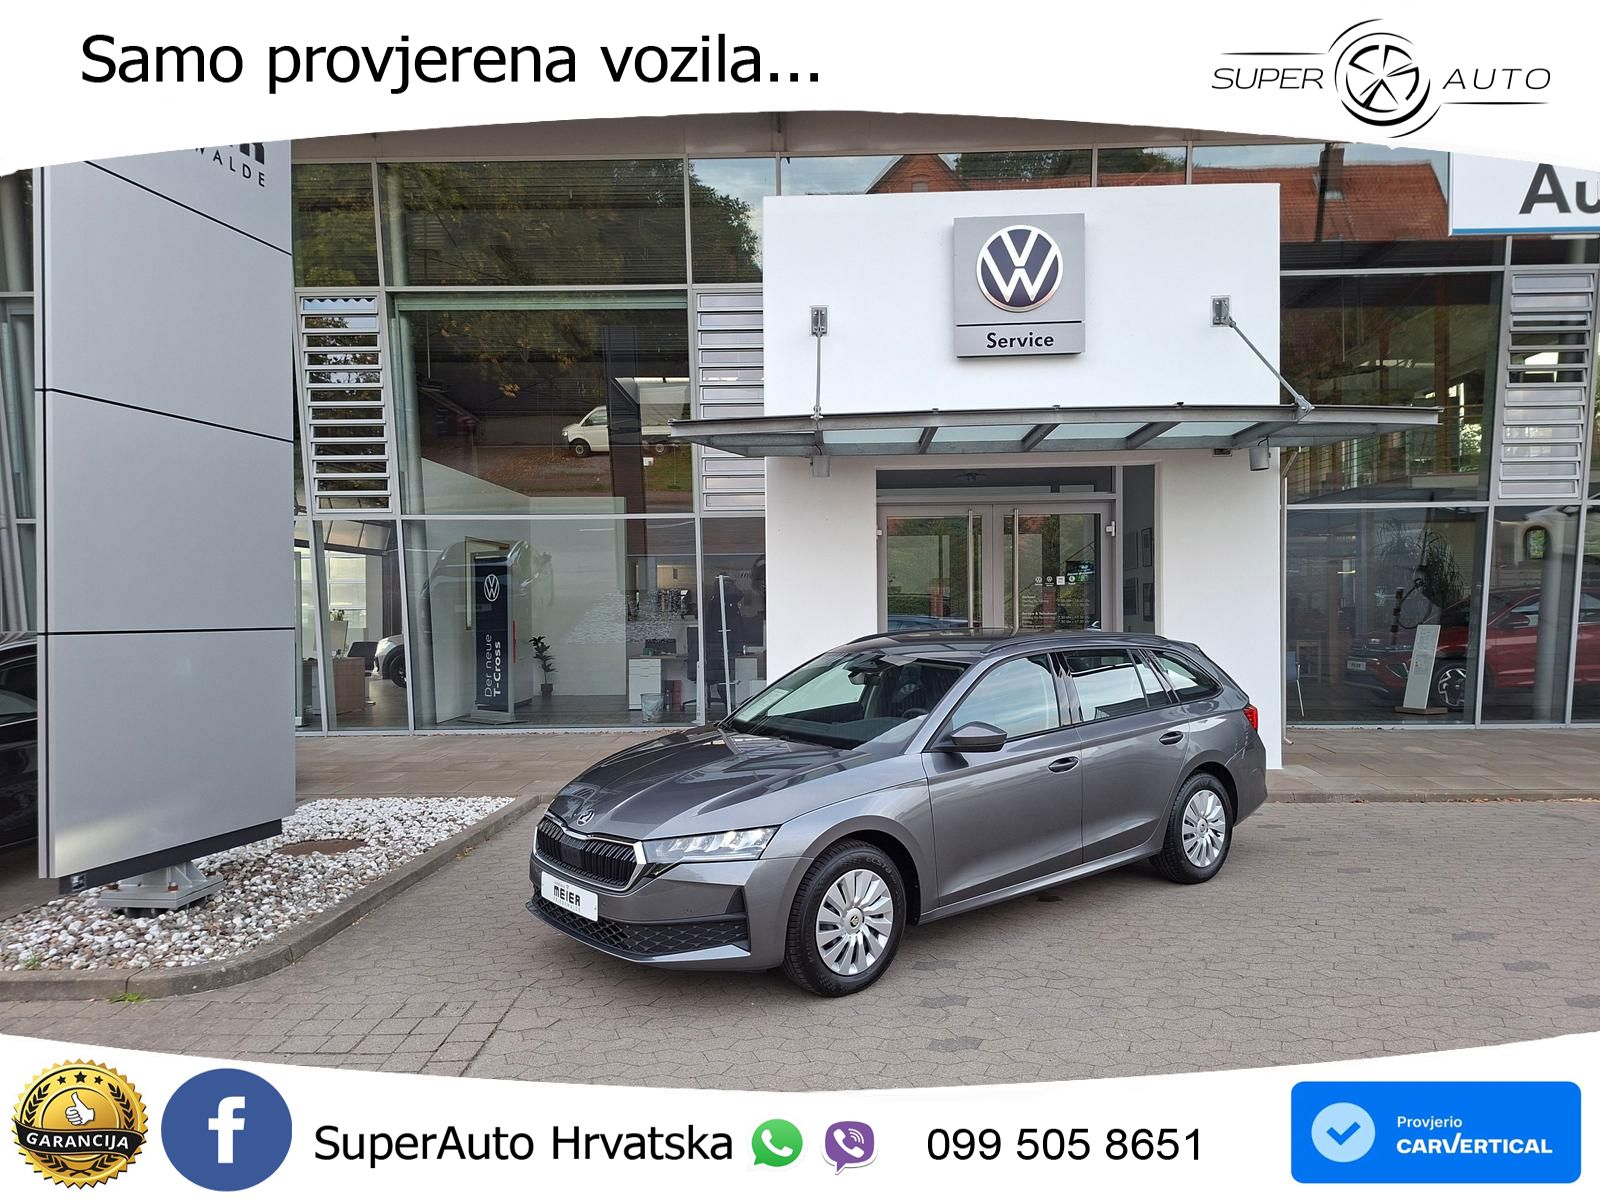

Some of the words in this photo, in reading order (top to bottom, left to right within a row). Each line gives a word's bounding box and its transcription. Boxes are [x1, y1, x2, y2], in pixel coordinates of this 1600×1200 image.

[986, 332, 1054, 348] Service
[493, 641, 501, 697] T-Cross
[484, 672, 492, 697] Der
